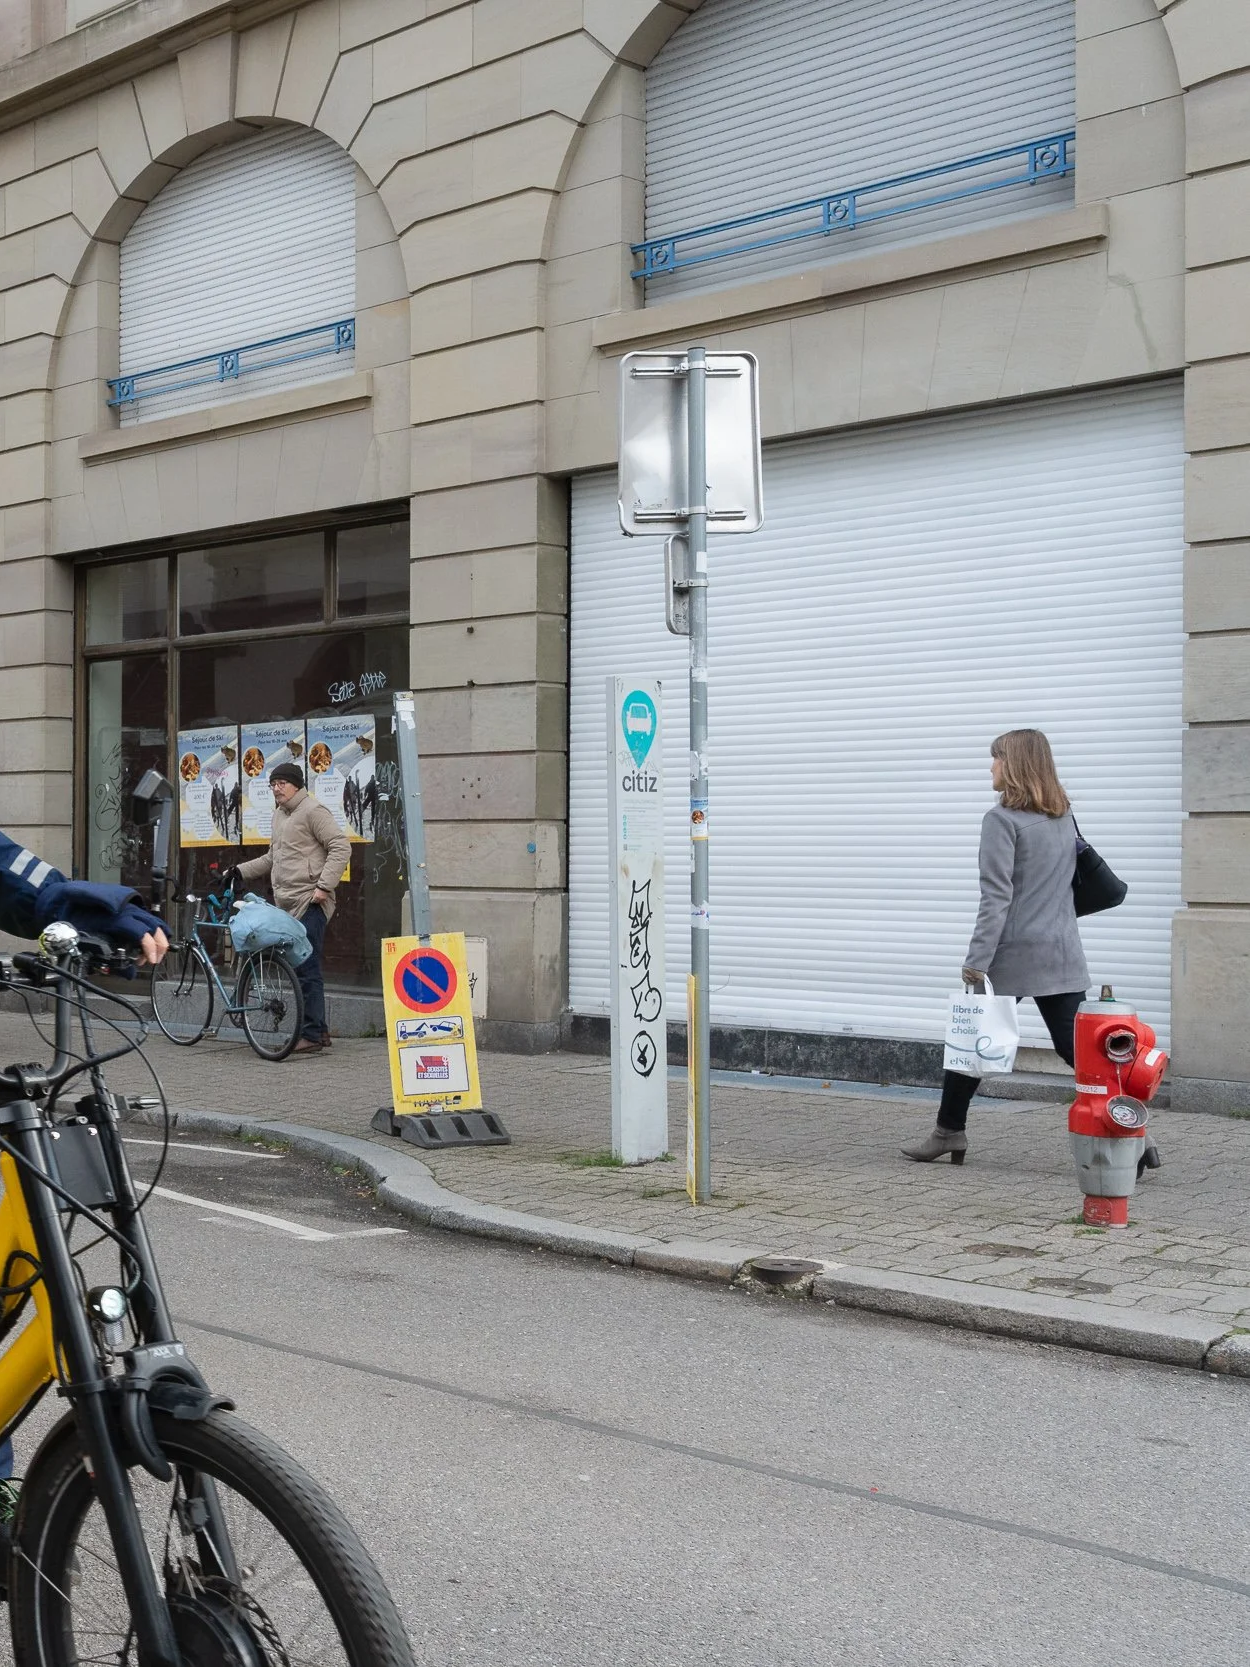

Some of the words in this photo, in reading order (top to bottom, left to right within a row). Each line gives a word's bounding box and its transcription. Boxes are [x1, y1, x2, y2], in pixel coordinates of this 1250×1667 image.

[255, 730, 272, 739] Séjour
[281, 728, 291, 736] Ski
[322, 725, 340, 734] Séjour
[350, 723, 359, 731] Ski
[191, 735, 207, 745] Séjour
[622, 770, 658, 793] citiz
[952, 1005, 971, 1014] libre
[972, 1006, 984, 1015] de
[952, 1015, 971, 1024] bien
[951, 1026, 979, 1035] choisir
